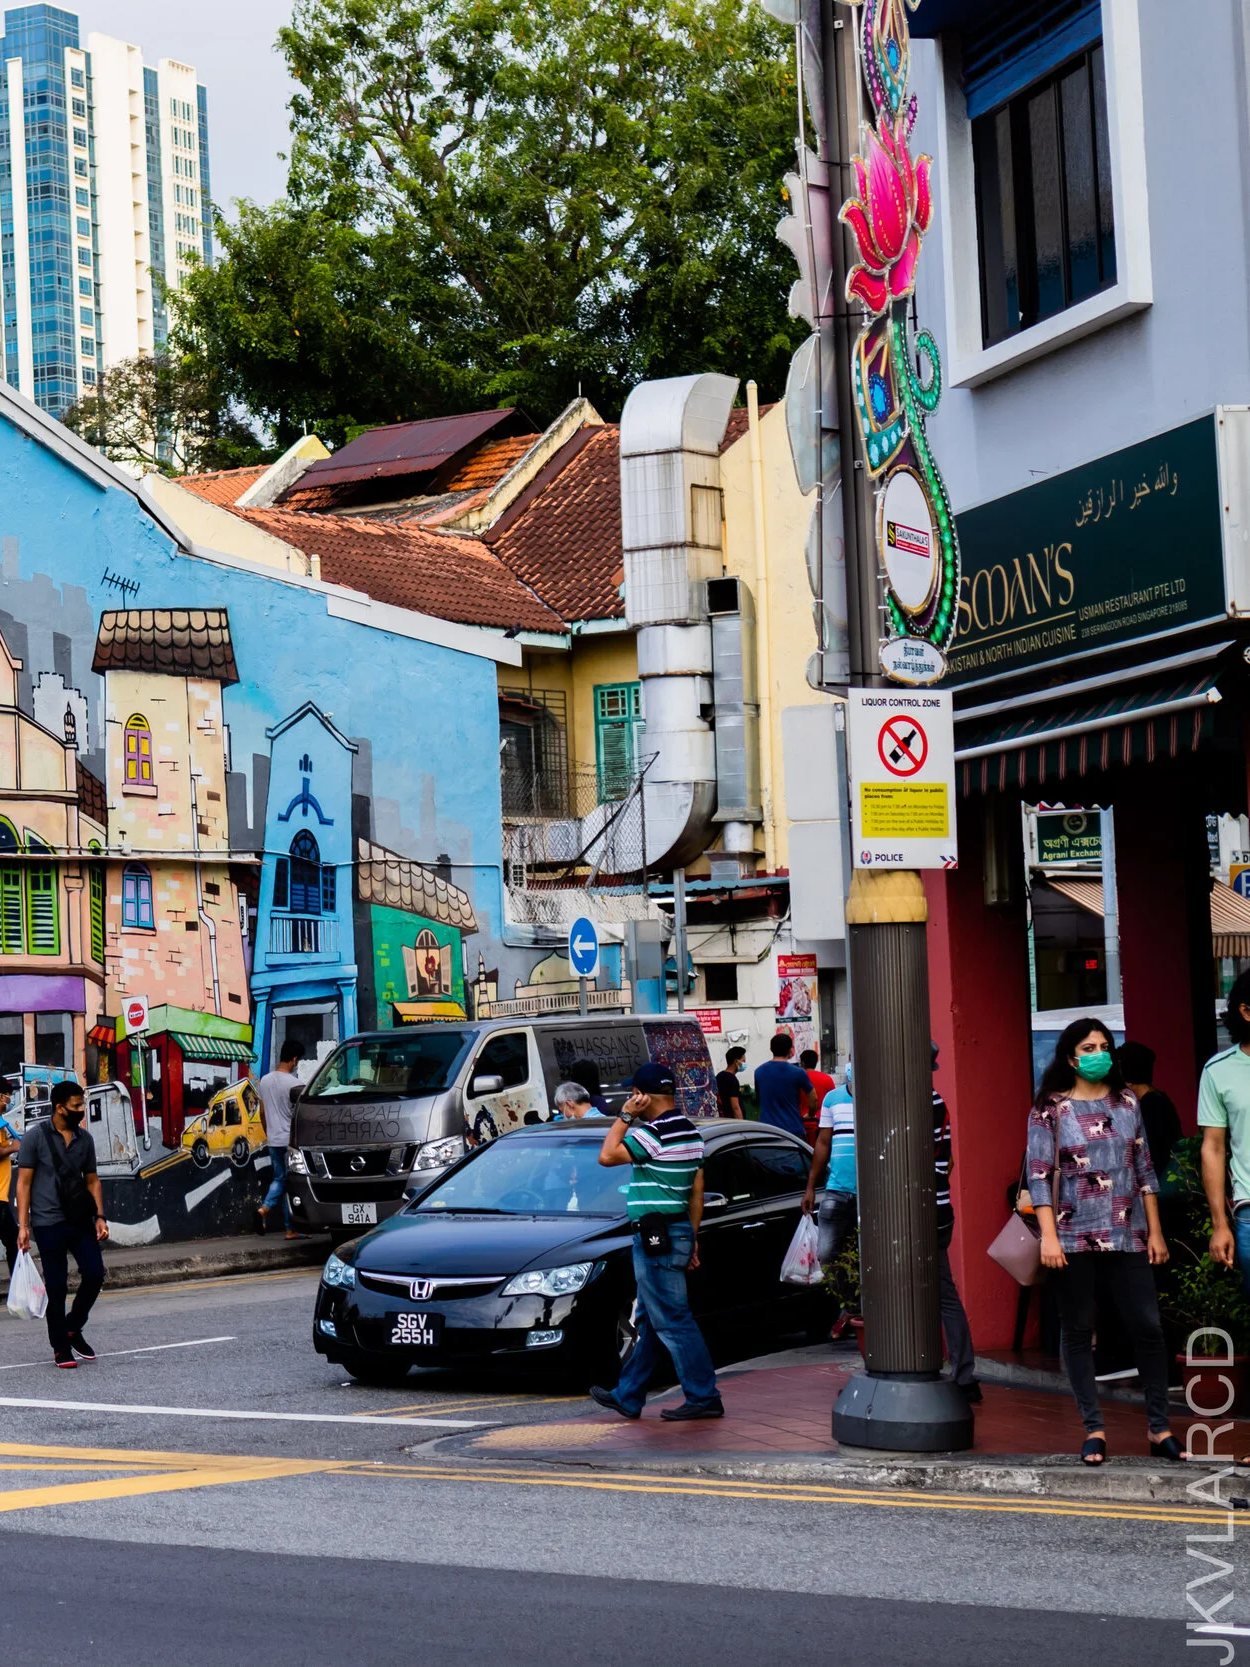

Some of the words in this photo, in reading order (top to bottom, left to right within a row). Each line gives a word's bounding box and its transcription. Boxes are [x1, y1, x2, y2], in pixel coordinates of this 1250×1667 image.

[953, 542, 1075, 637] SMAN'S
[1078, 602, 1104, 621] USMAN
[1105, 587, 1153, 614] RESTAURANT
[1154, 583, 1170, 600] PTE
[1170, 578, 1186, 595] LTD
[1122, 614, 1137, 627] ROAD
[1137, 605, 1168, 623] SINGAPORE
[945, 652, 979, 674] AKISTANI
[980, 650, 985, 665] &
[985, 643, 1013, 663] NORTH
[1013, 634, 1041, 656] INDIAN
[1041, 623, 1077, 648] CUISINE
[861, 698, 887, 707] LIQUOR
[888, 698, 922, 708] CONTROL
[922, 699, 941, 708] ZONE
[874, 853, 904, 862] POLICE
[1042, 850, 1069, 861] Agrani
[573, 1034, 640, 1057] HASSAN'S
[352, 1205, 365, 1214] GX
[348, 1213, 371, 1224] 941A
[397, 1313, 427, 1329] SGV
[391, 1327, 433, 1345] 255H
